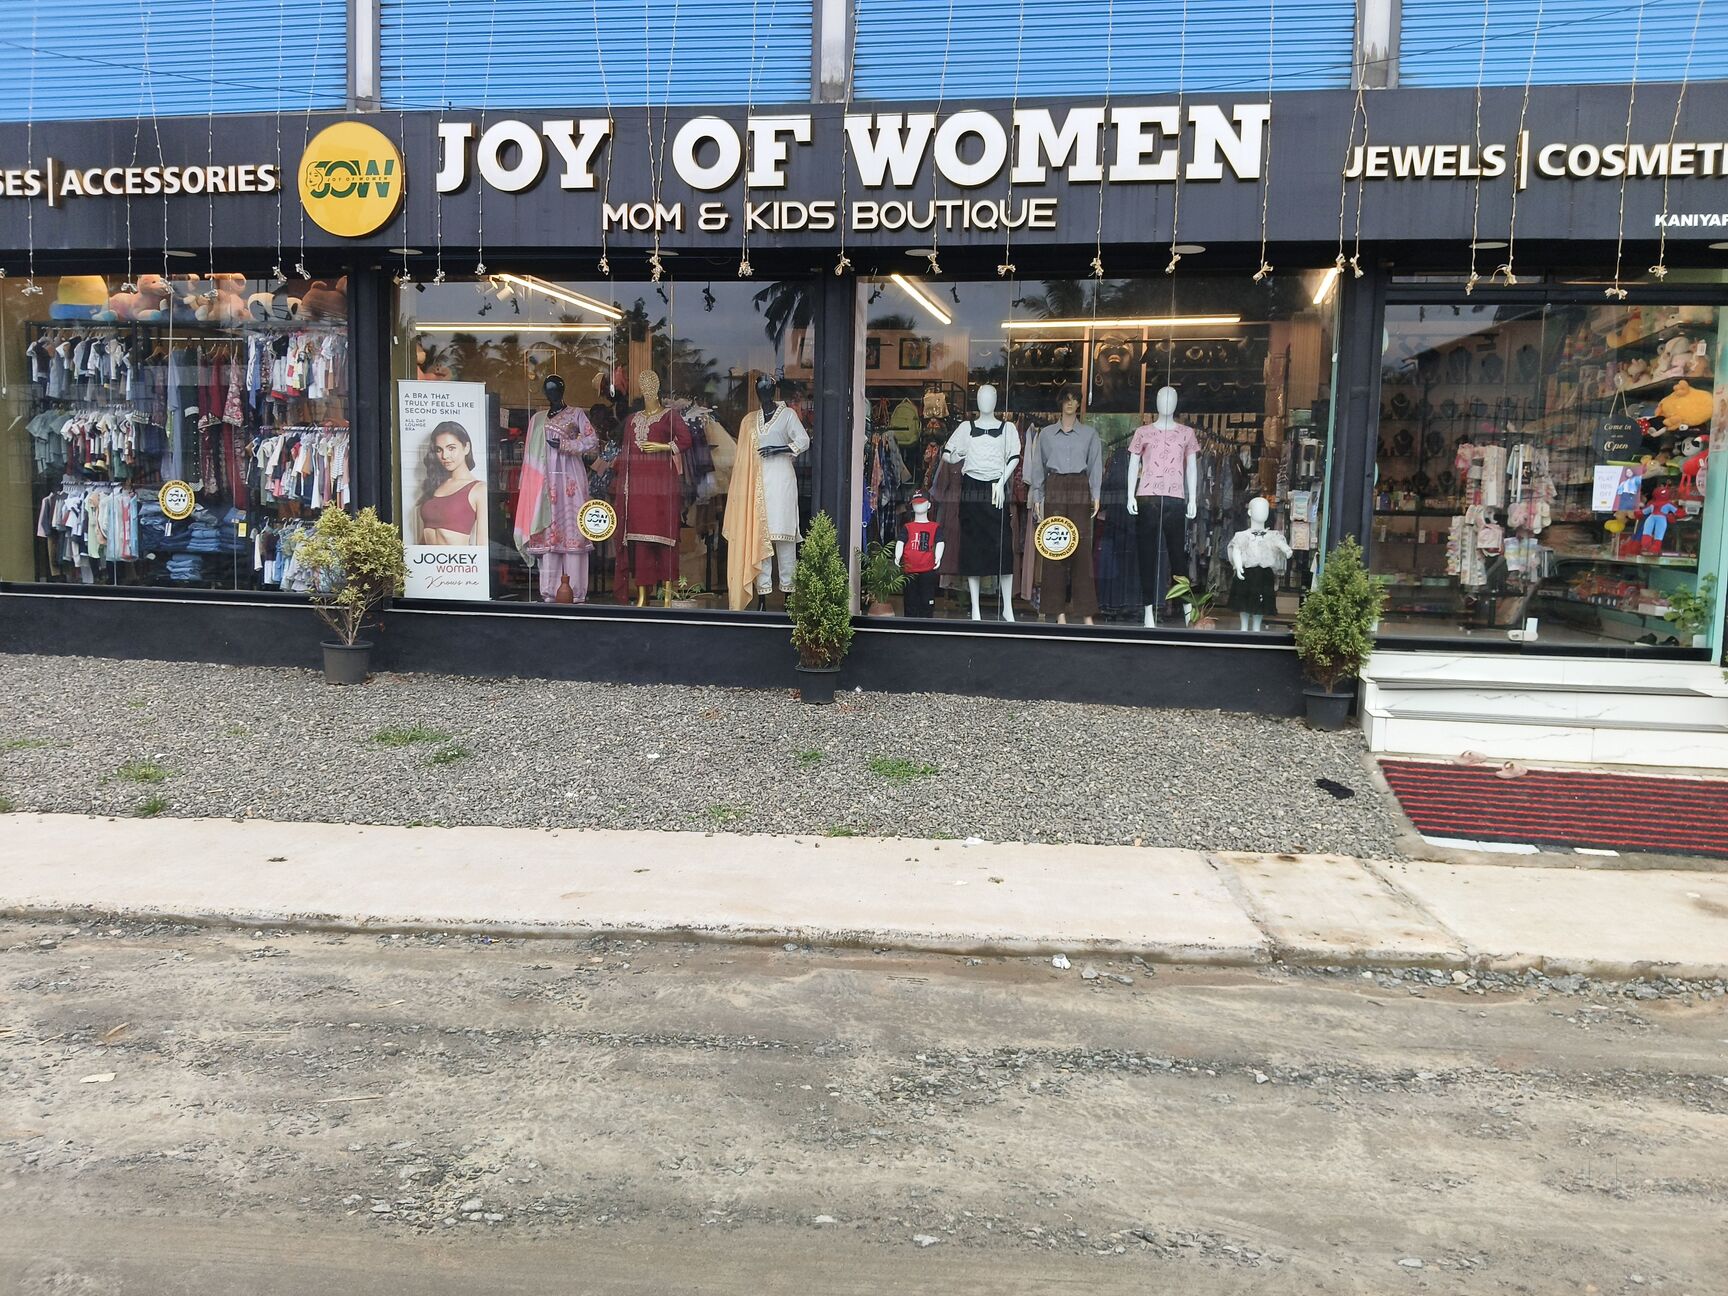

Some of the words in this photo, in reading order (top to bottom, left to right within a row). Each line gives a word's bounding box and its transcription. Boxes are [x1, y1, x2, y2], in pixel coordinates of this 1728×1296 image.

[436, 118, 611, 192] JOY
[672, 116, 812, 190] OF
[843, 104, 1271, 187] WOMEN
[1345, 143, 1506, 177] JEWELS
[0, 168, 41, 196] ES
[60, 164, 276, 196] ACCESSORIES
[603, 202, 682, 231] MOM
[698, 202, 730, 231] &
[746, 200, 836, 231] KIDS
[852, 198, 1058, 231] BOUTIQUE
[1604, 422, 1623, 431] Come
[1604, 441, 1629, 452] Open
[413, 553, 477, 564] JOCKEY
[436, 565, 478, 573] woman
